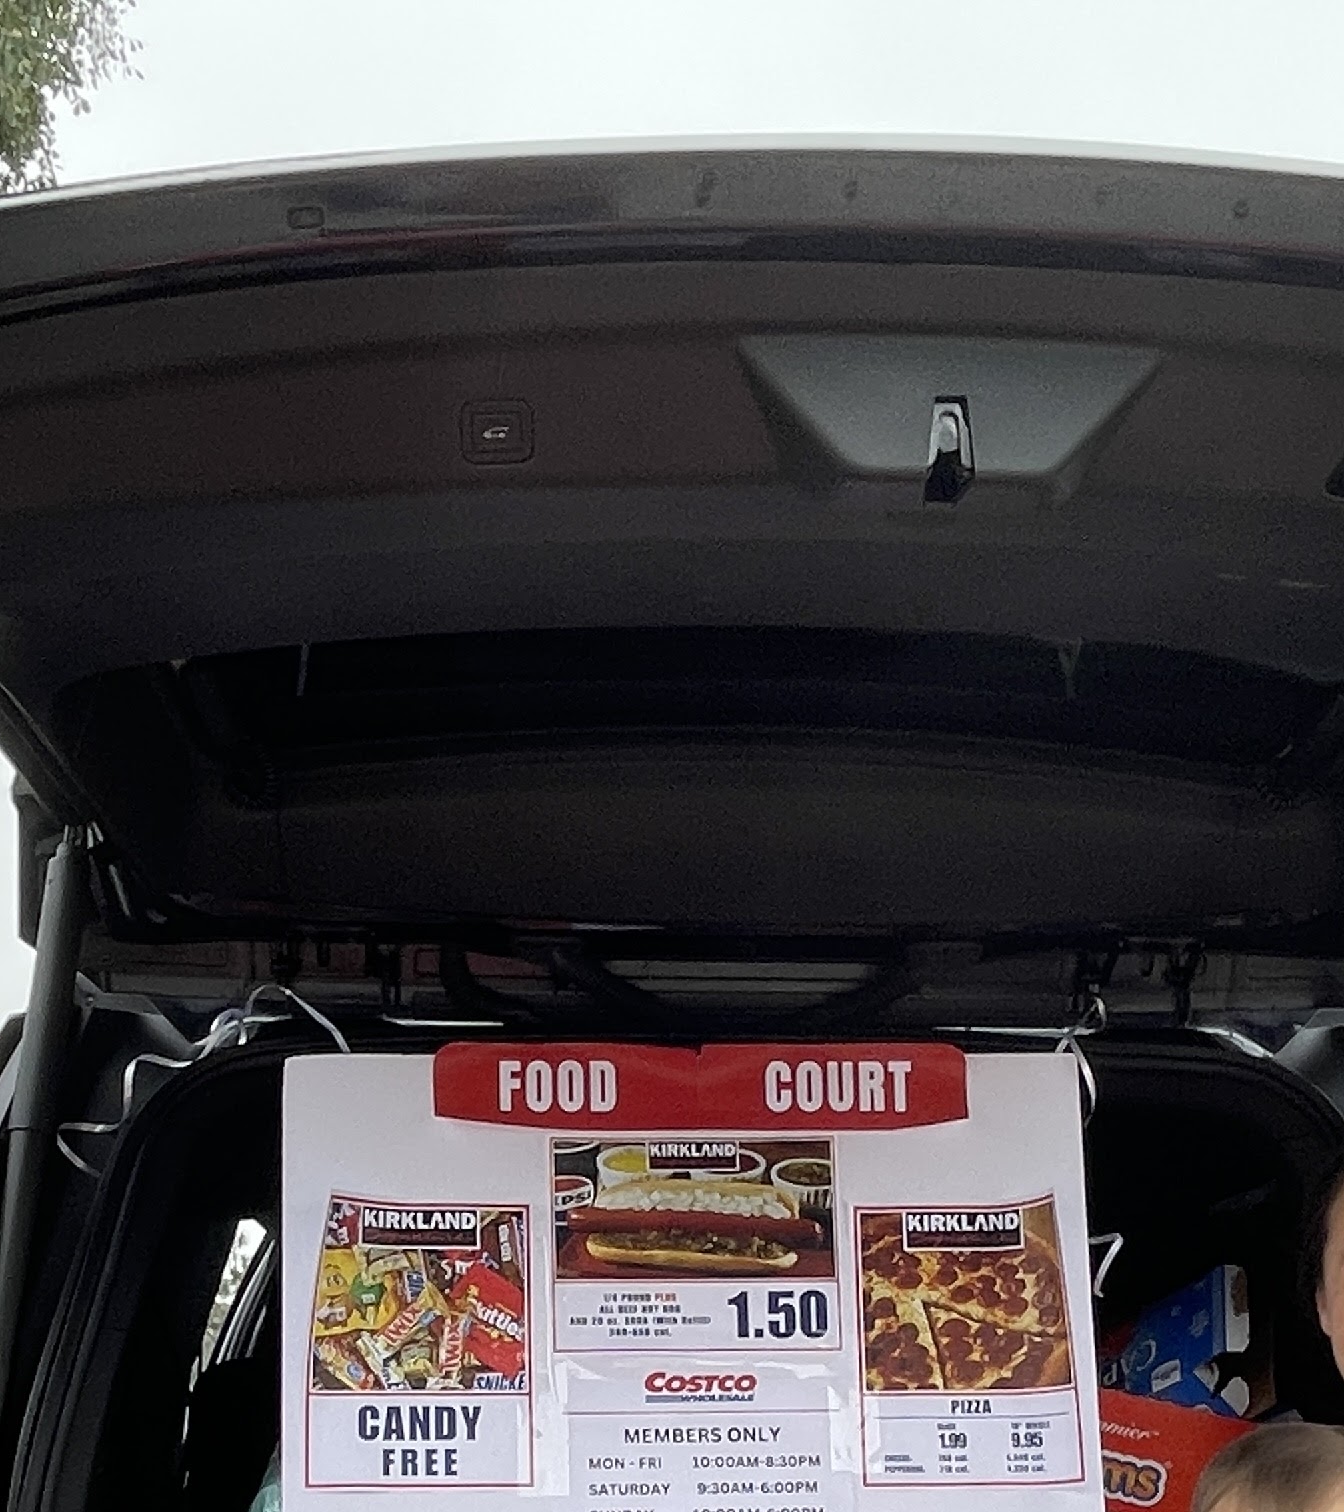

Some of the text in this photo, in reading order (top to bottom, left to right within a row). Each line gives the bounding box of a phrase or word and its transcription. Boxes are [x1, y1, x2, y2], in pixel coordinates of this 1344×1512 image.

[498, 1060, 913, 1112] FOOD COURT
[649, 1143, 737, 1158] KIRKLAND
[364, 1208, 476, 1230] KIRKLAND
[907, 1213, 1020, 1232] KIRKLAND
[727, 1290, 828, 1338] 1.50
[645, 1372, 757, 1393] COSTCO
[680, 1394, 754, 1402] WHOLESALE
[950, 1399, 991, 1414] PIZZA
[358, 1405, 482, 1441] CANDY
[623, 1427, 782, 1443] MEMBERS ONLY
[938, 1432, 1043, 1449] 1.99 9.95
[382, 1449, 458, 1476] FREE
[588, 1457, 625, 1469] MON
[639, 1457, 662, 1469] FRI
[692, 1455, 822, 1468] 10:00AM-8:30PM
[588, 1481, 819, 1496] SATURDAY 9:30AM-6:00PM
